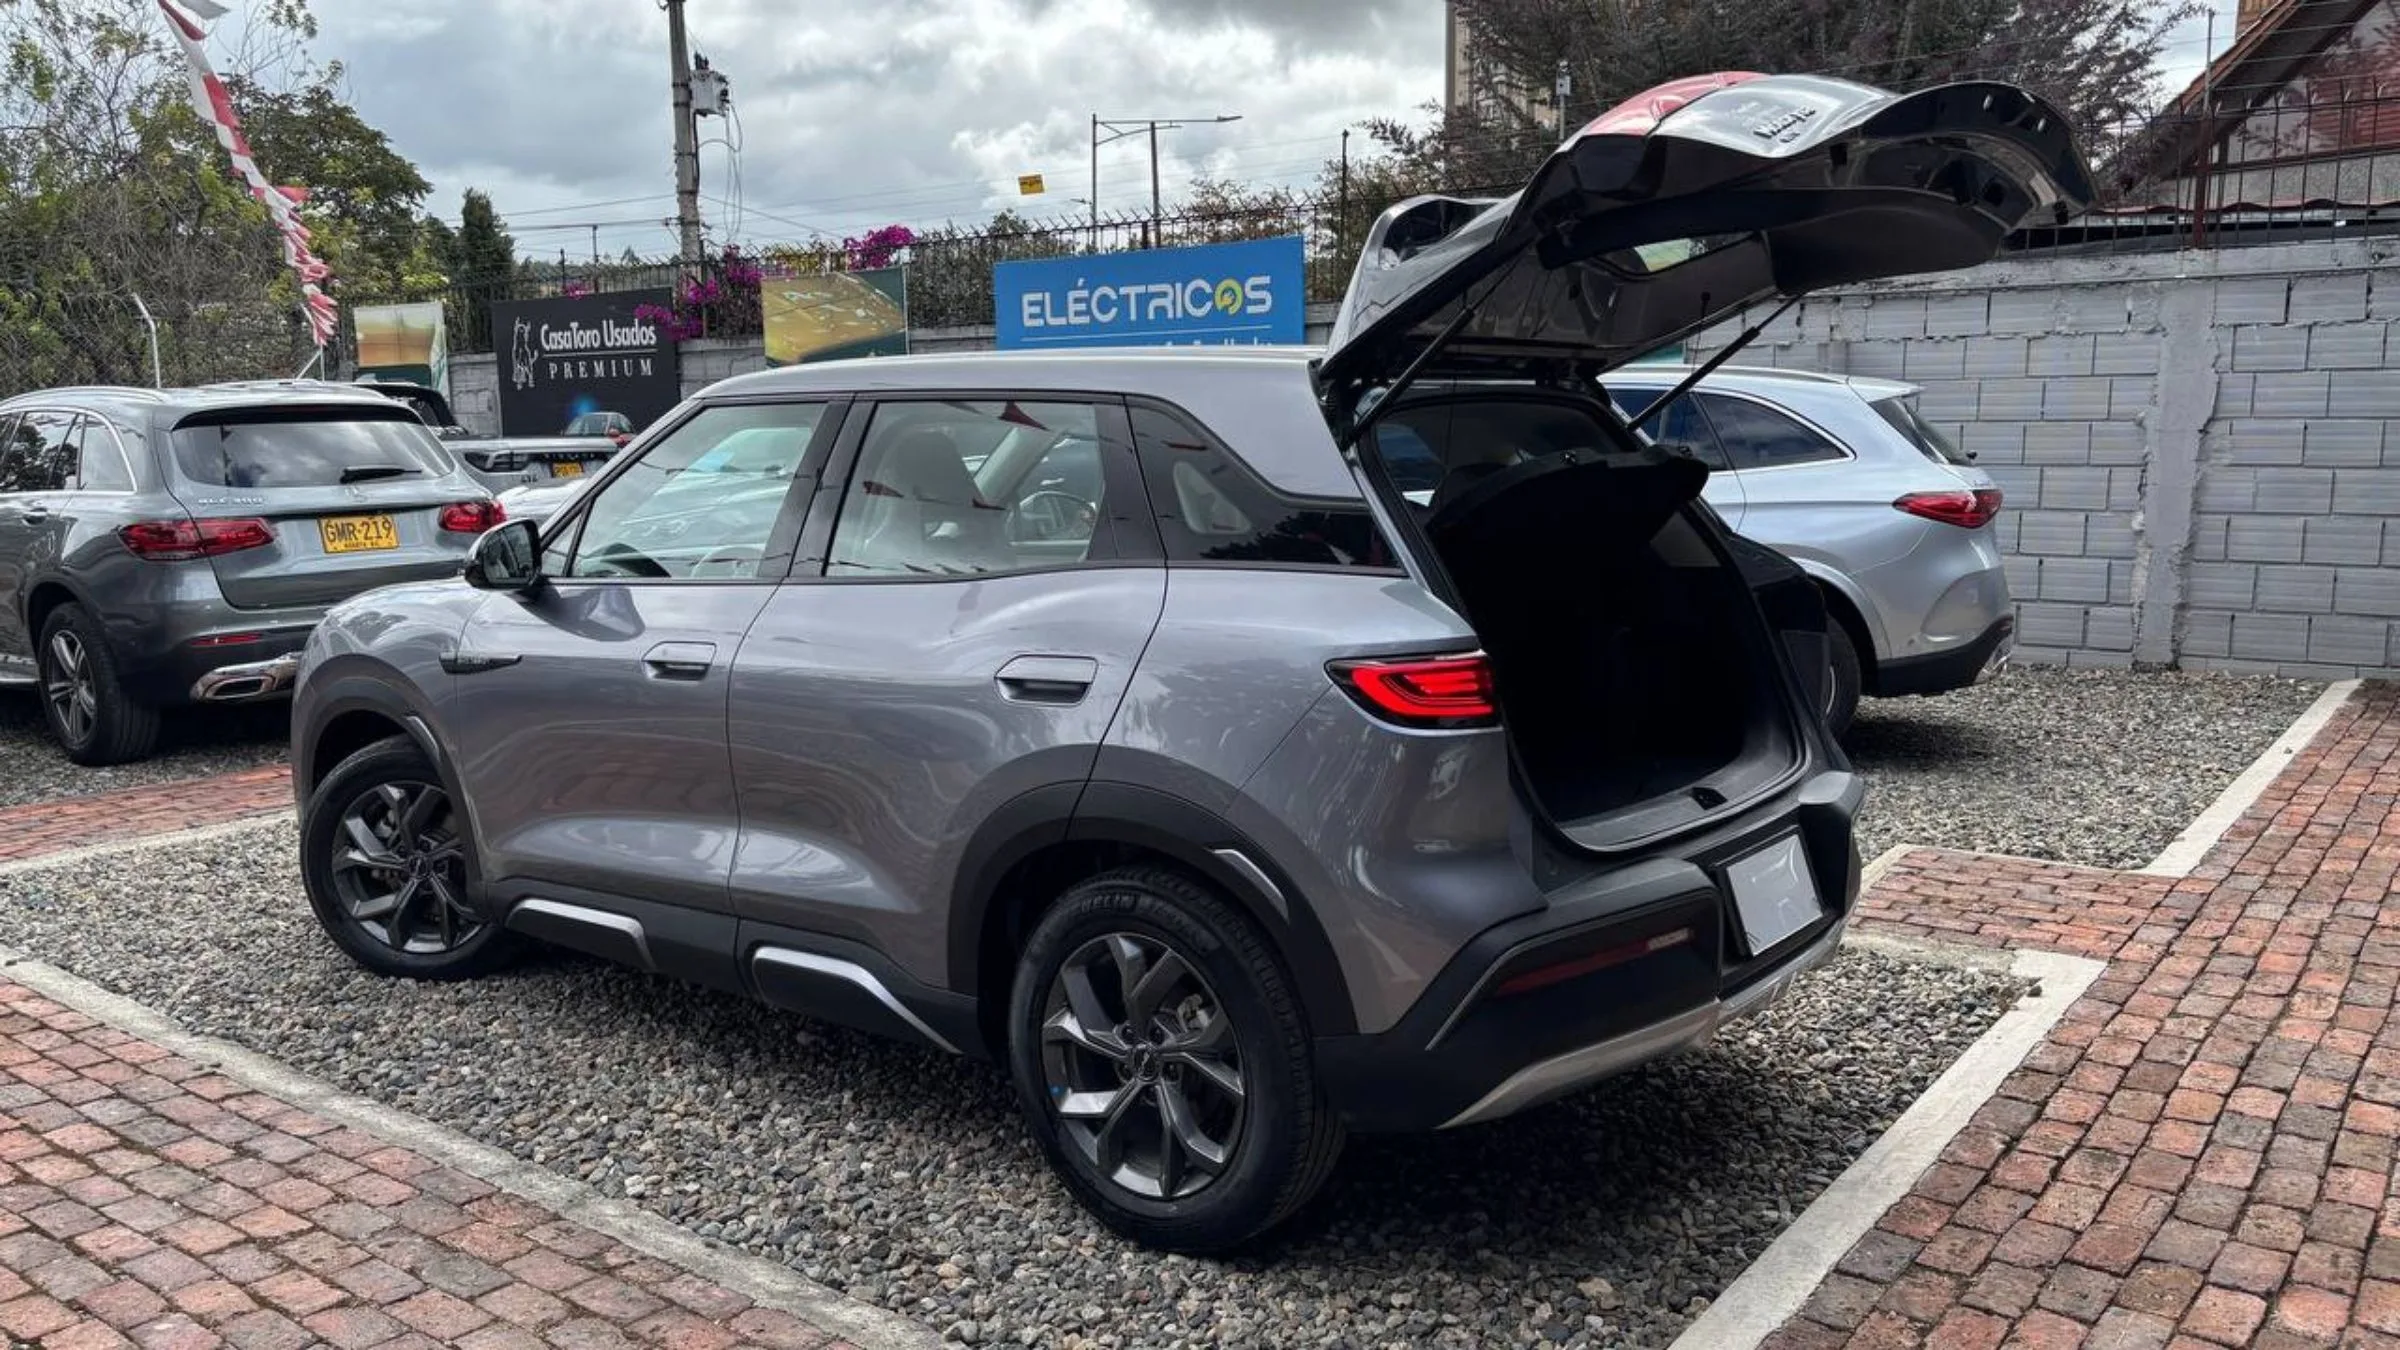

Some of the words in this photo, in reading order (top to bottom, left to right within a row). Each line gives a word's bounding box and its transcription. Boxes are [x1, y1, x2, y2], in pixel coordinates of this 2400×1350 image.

[1021, 275, 1273, 327] ELÉCTRICOS
[540, 321, 601, 351] CasaToro
[602, 318, 657, 348] Usados
[549, 358, 652, 380] PREMIUM
